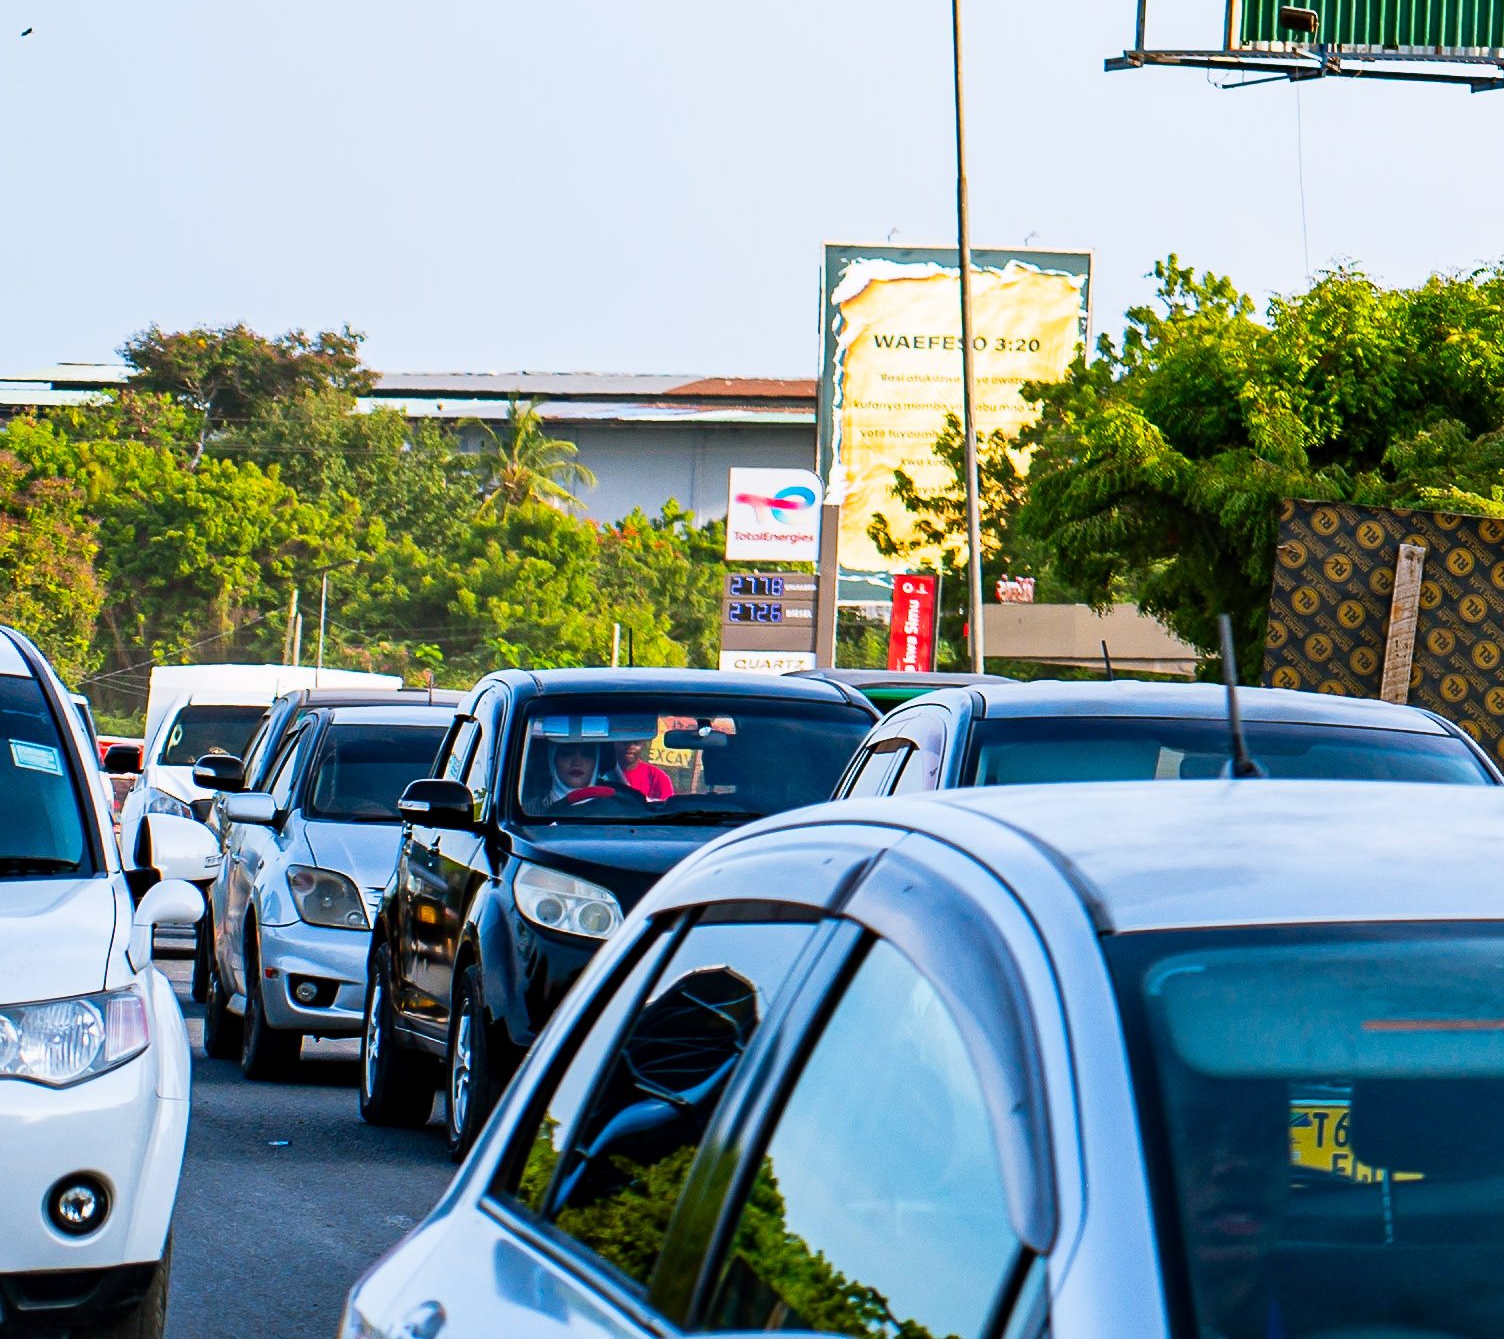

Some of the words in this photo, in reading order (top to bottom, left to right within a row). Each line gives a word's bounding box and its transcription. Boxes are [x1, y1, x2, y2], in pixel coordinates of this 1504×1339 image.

[995, 338, 1040, 352] 3:20
[1316, 511, 1334, 529] RL
[735, 531, 813, 544] TotalEnergies
[1360, 525, 1378, 543] RL
[1328, 558, 1346, 576] RL
[1451, 552, 1469, 570] RL
[730, 576, 784, 596] 2778
[729, 603, 782, 622] 2726
[1342, 605, 1359, 622] RL
[1463, 599, 1481, 617] RL
[1310, 638, 1327, 655] RL
[1432, 632, 1449, 649] RL
[734, 658, 805, 670] QUARTZ
[1354, 652, 1371, 669] RL
[1277, 670, 1295, 688] RL
